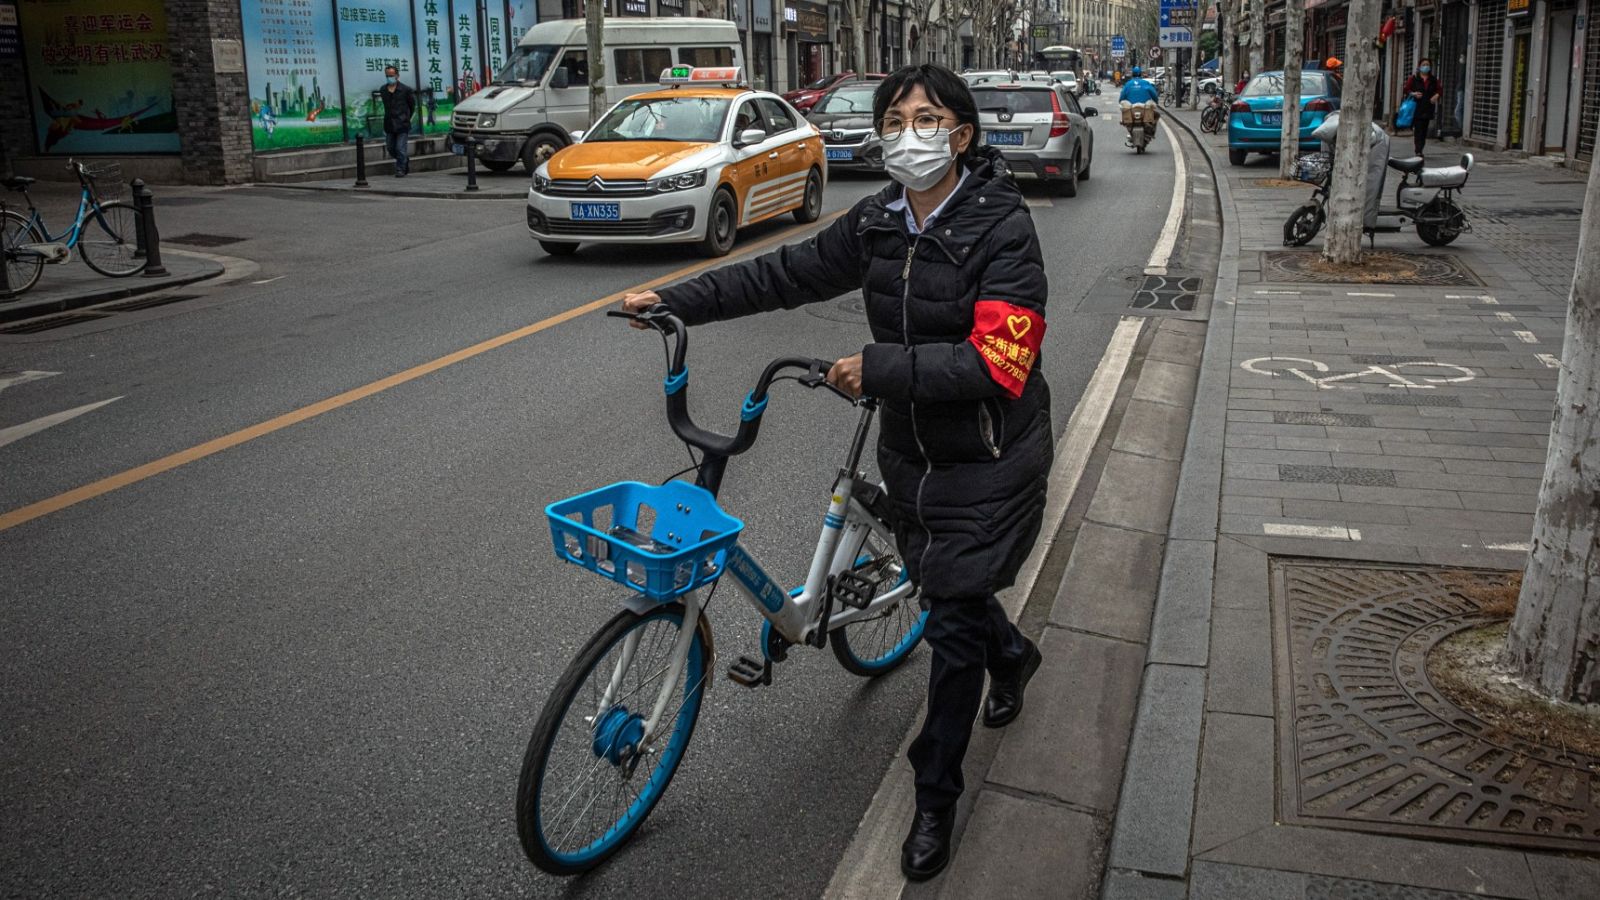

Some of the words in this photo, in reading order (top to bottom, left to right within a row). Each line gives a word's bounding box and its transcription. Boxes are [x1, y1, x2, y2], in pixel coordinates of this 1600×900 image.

[340, 7, 386, 23] 迎接军运会
[64, 14, 153, 33] 喜迎军运会
[355, 32, 400, 48] 打造新环境
[1169, 31, 1192, 42] 黎黄陂
[424, 0, 443, 92] 体育传友谊
[490, 17, 502, 80] 同筑和
[365, 58, 409, 72] 当好东道主
